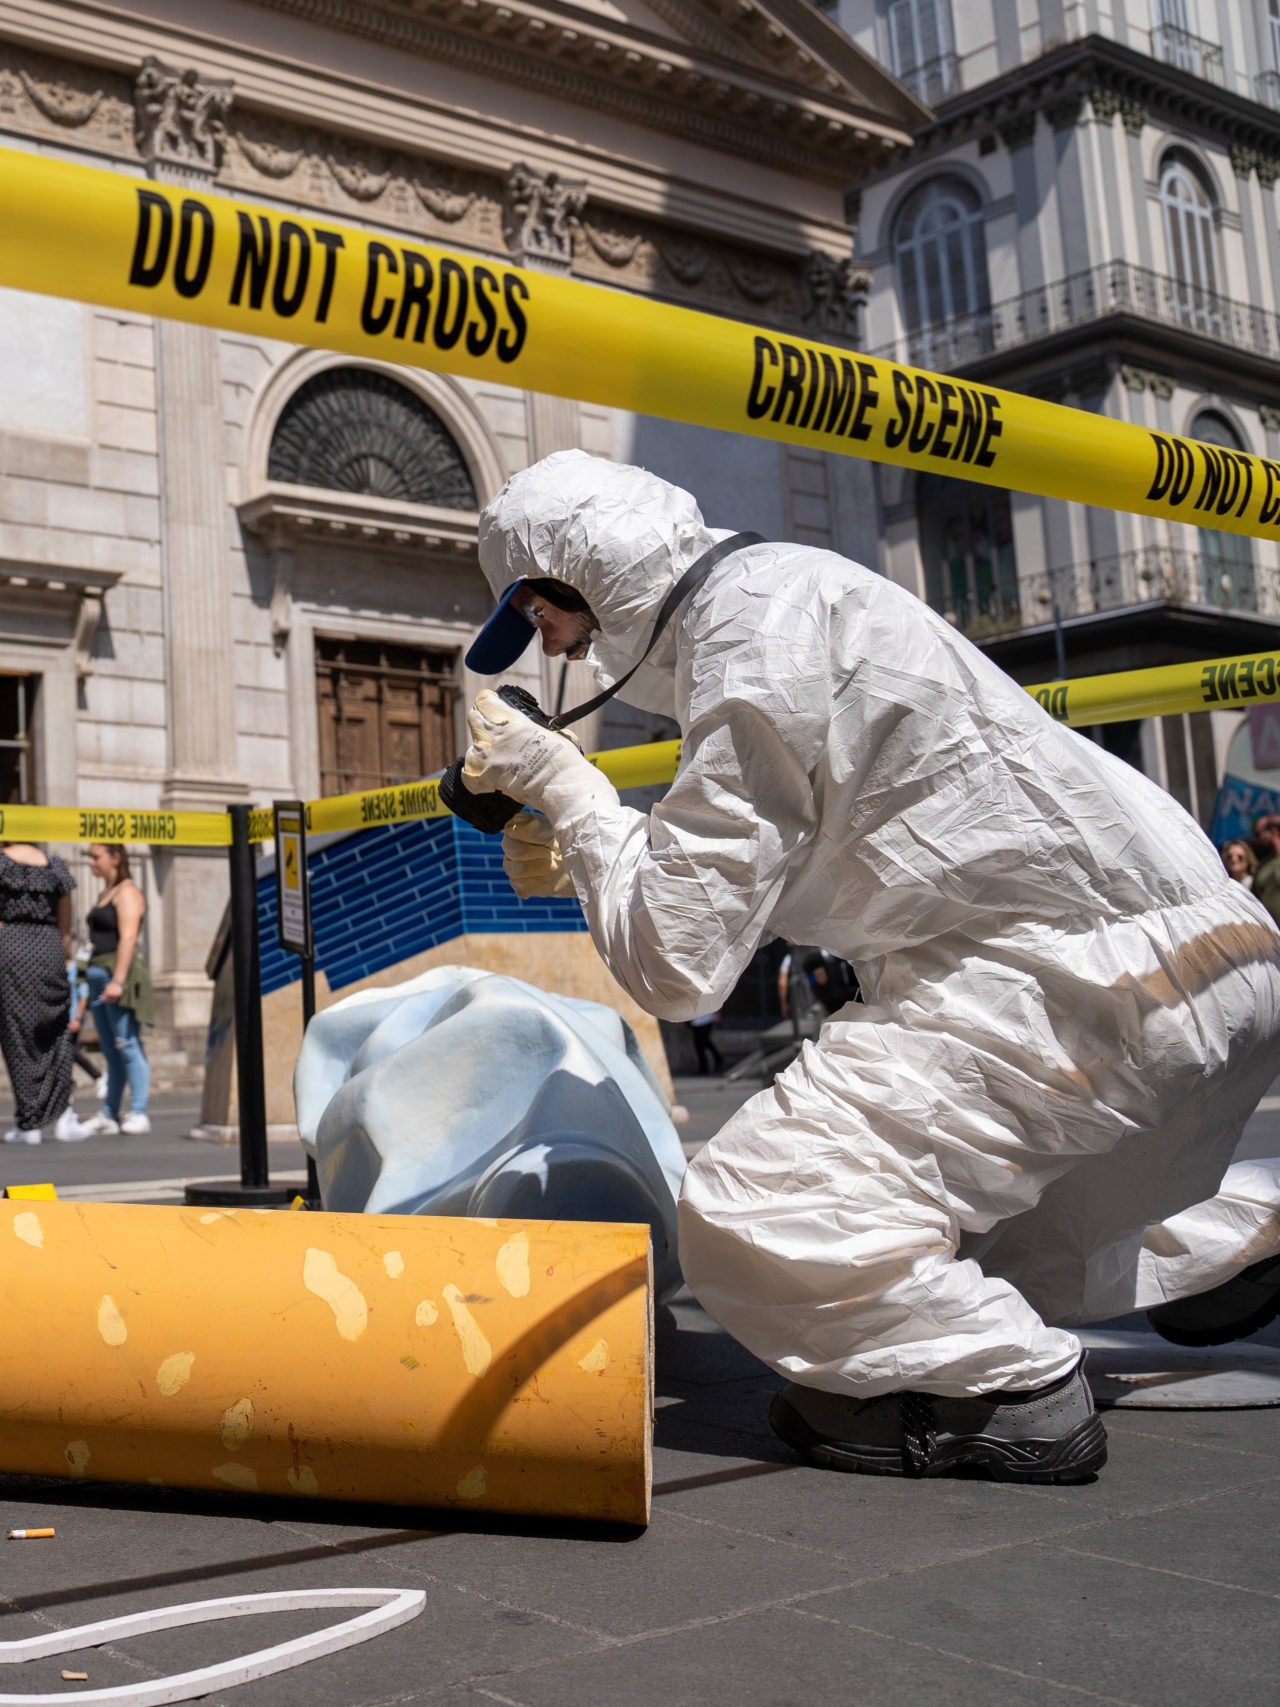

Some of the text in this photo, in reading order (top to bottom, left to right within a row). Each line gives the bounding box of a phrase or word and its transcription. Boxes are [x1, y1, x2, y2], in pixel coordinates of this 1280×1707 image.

[128, 187, 531, 363] DO NOT CROSS
[746, 335, 1003, 468] CRIME SCENE
[1146, 432, 1195, 506] DO
[1193, 444, 1255, 518] NOT
